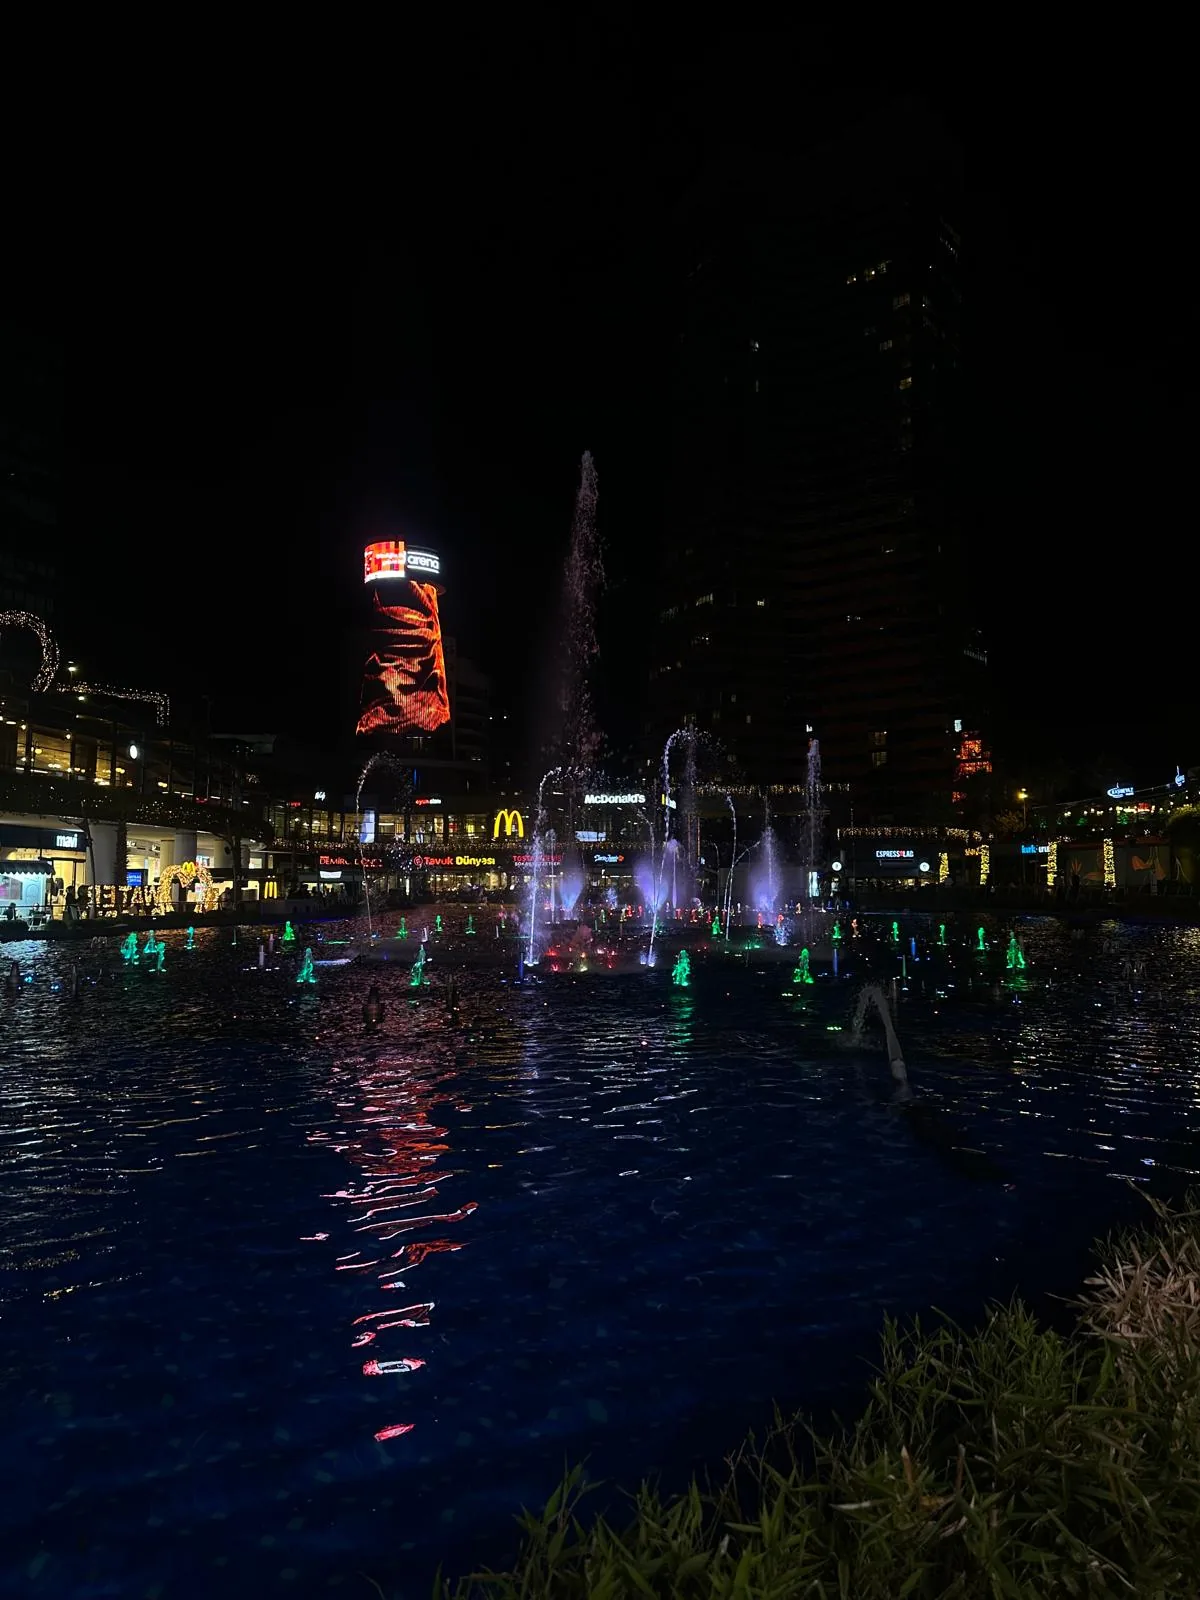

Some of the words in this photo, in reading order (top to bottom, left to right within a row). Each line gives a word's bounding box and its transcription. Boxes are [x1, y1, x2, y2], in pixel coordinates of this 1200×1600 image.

[408, 555, 440, 570] arena
[584, 793, 646, 804] McDonald's
[56, 833, 78, 848] mavi
[423, 856, 454, 865] Tavuk
[455, 856, 496, 867] Dünyası
